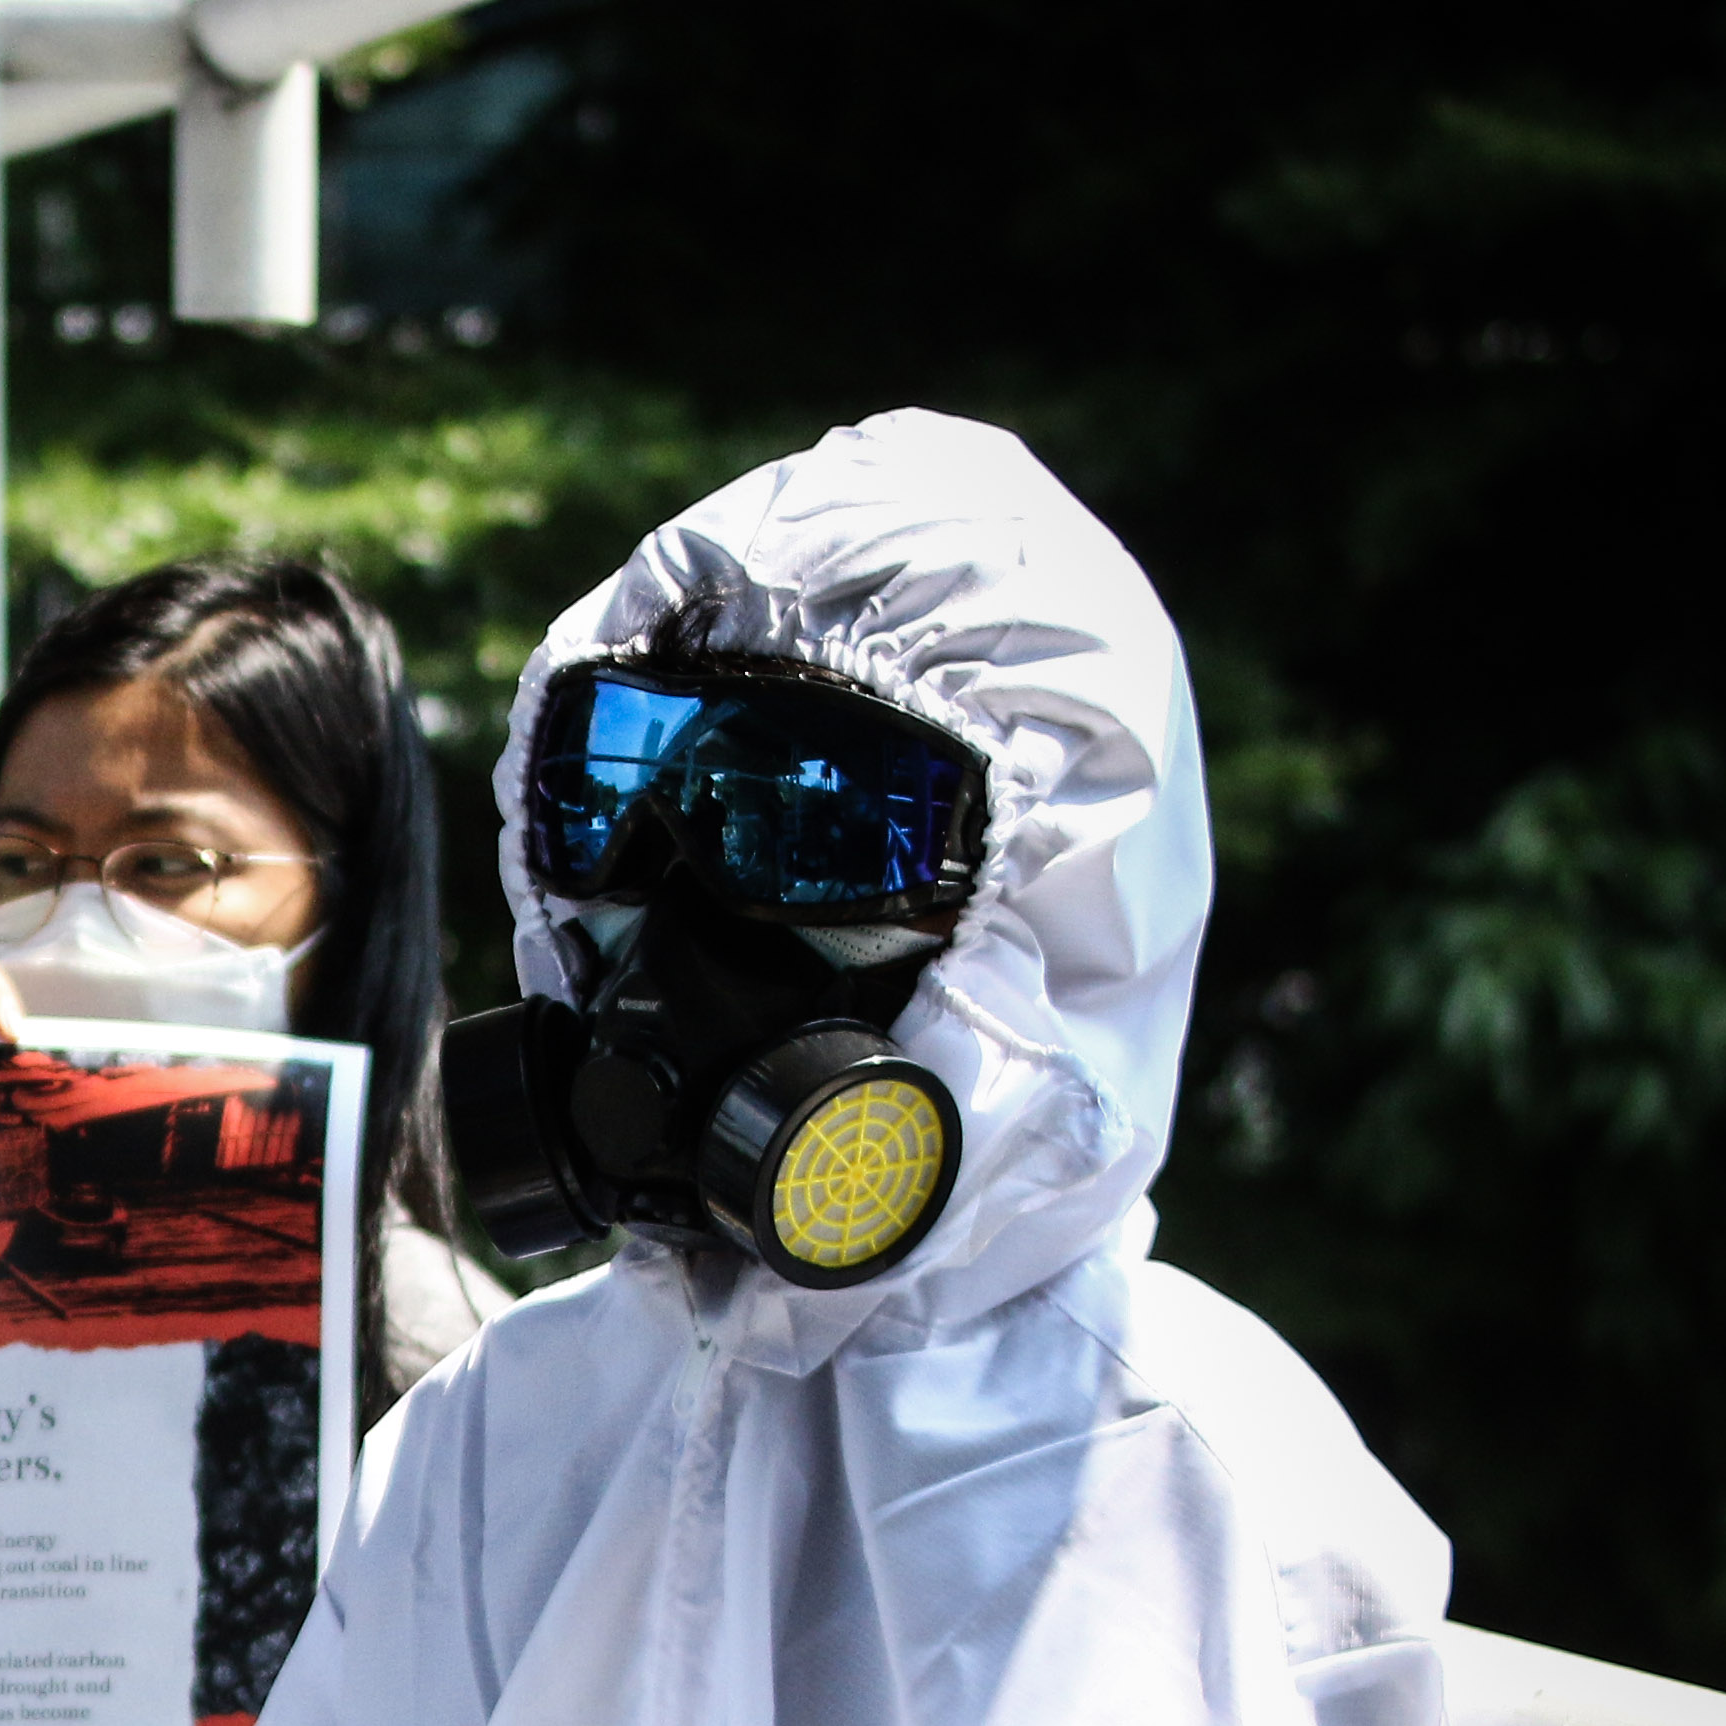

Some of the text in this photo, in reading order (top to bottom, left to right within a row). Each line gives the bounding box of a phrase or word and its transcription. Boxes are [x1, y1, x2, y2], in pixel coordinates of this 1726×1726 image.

[5, 1559, 35, 1573] out
[41, 1556, 78, 1572] coal
[86, 1556, 104, 1571] in
[111, 1554, 148, 1571] line
[58, 1652, 125, 1668] carbon
[75, 1678, 110, 1694] and
[21, 1704, 90, 1720] become
